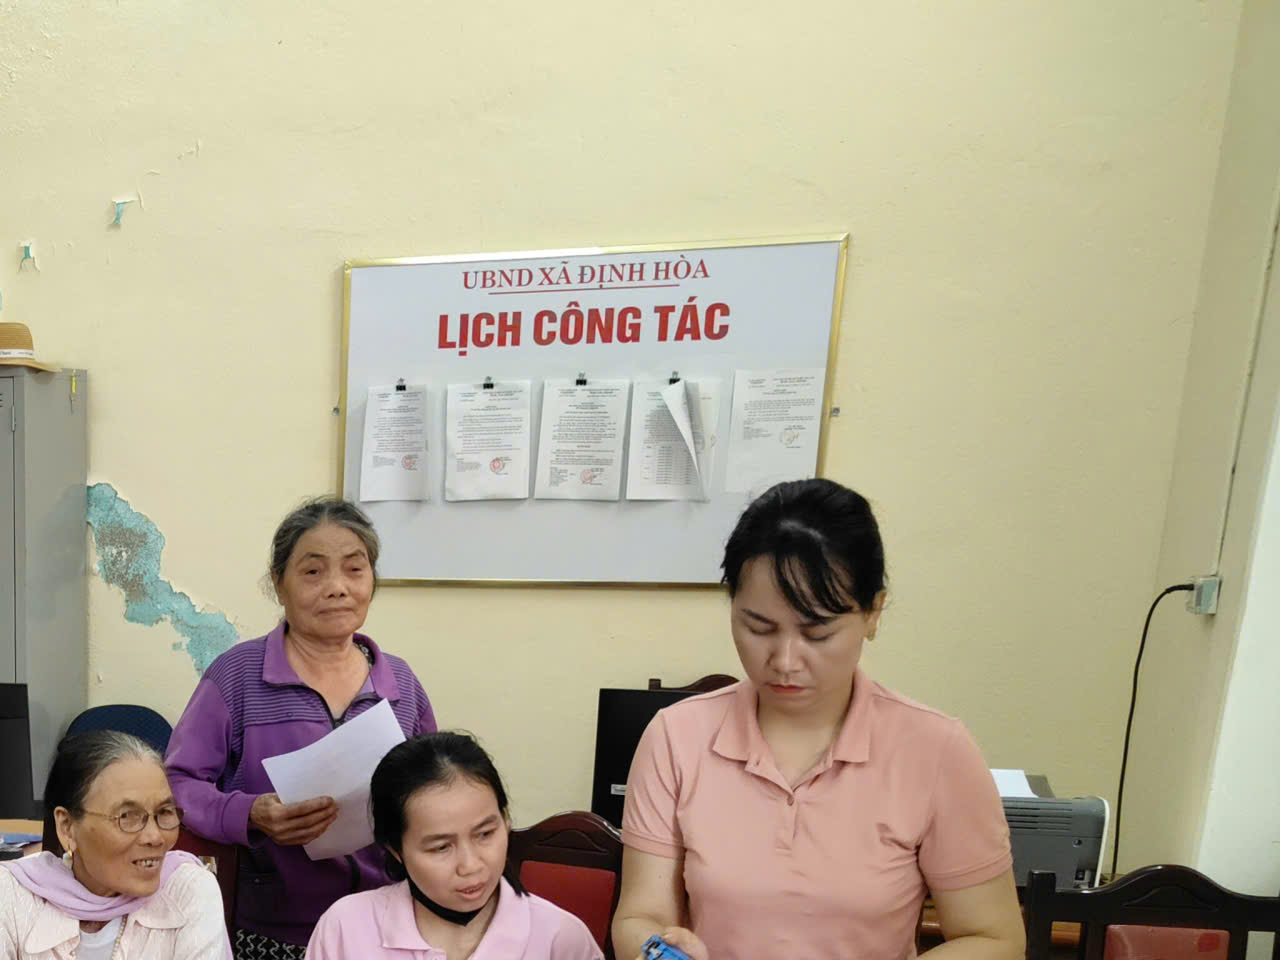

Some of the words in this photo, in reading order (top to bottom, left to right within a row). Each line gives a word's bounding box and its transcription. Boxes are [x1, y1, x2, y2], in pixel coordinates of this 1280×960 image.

[462, 267, 533, 290] UBND
[538, 261, 572, 286] XÃ
[578, 262, 646, 289] ĐỊNH
[652, 254, 710, 281] HÒA
[438, 310, 522, 357] LỊCH
[533, 300, 642, 346] CÔNG
[653, 296, 731, 342] TÁC
